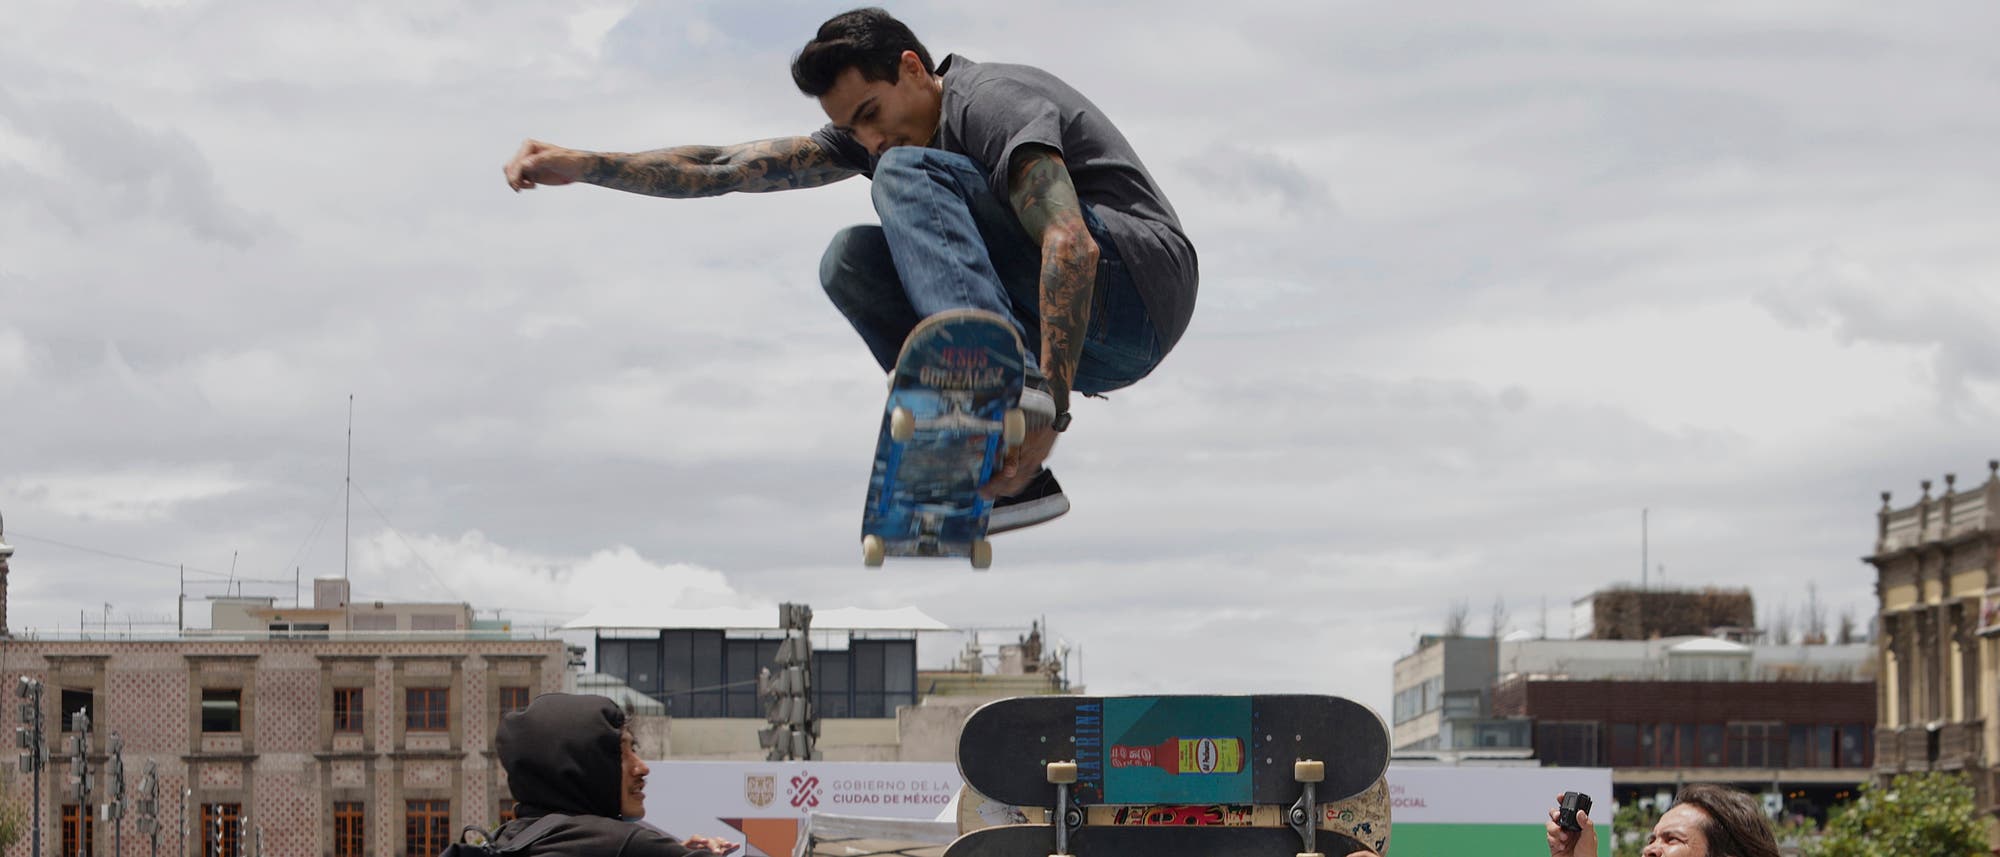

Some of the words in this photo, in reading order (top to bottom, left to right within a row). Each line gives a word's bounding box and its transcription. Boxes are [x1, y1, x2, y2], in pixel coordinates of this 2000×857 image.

[832, 780, 906, 791] GOBIERNO
[911, 780, 928, 791] DE
[933, 780, 950, 791] LA
[832, 794, 880, 804] CIUDAD
[883, 794, 900, 804] DE
[903, 791, 951, 804] MÉXICO
